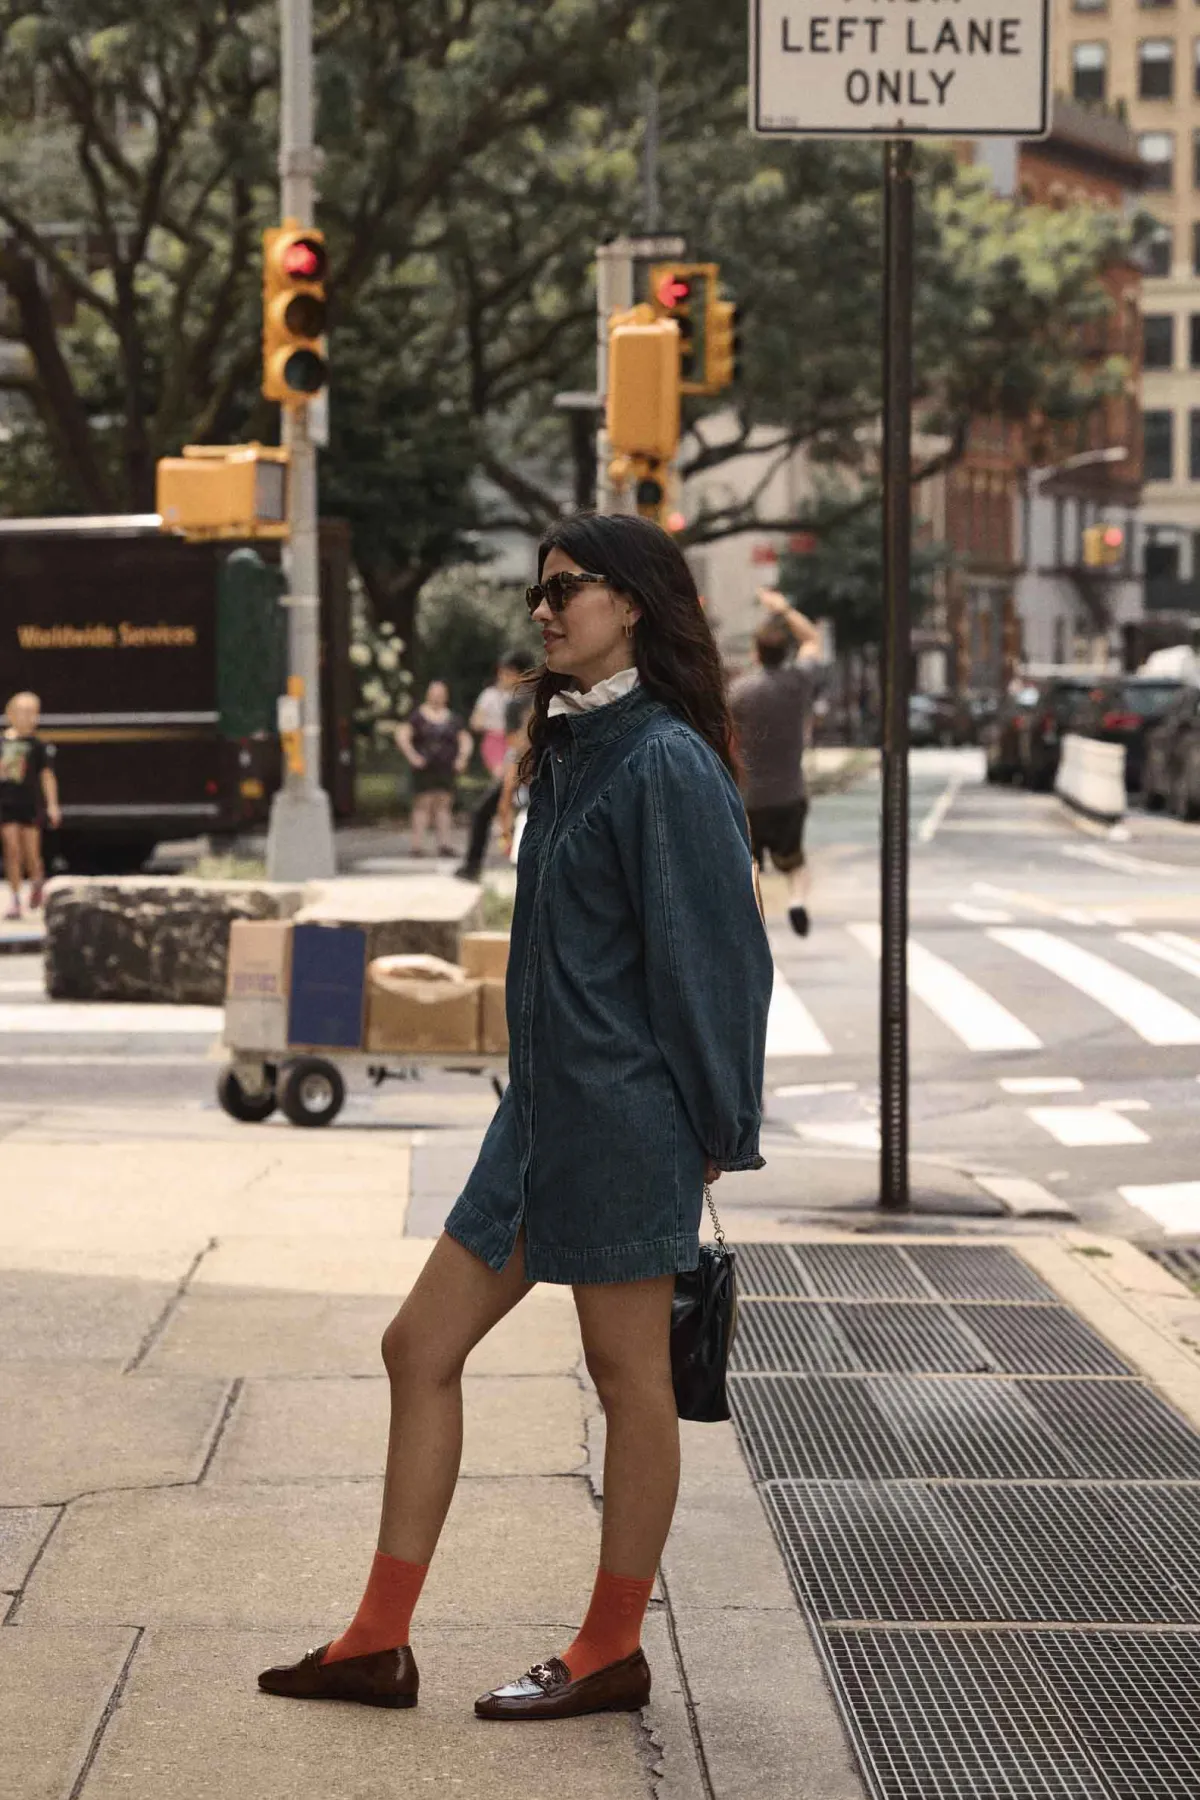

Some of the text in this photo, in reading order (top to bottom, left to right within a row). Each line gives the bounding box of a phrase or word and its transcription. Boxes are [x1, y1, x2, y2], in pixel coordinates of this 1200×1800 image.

[781, 16, 1022, 55] LEFT LANE
[844, 68, 956, 107] ONLY
[17, 621, 197, 649] Worldwide Services
